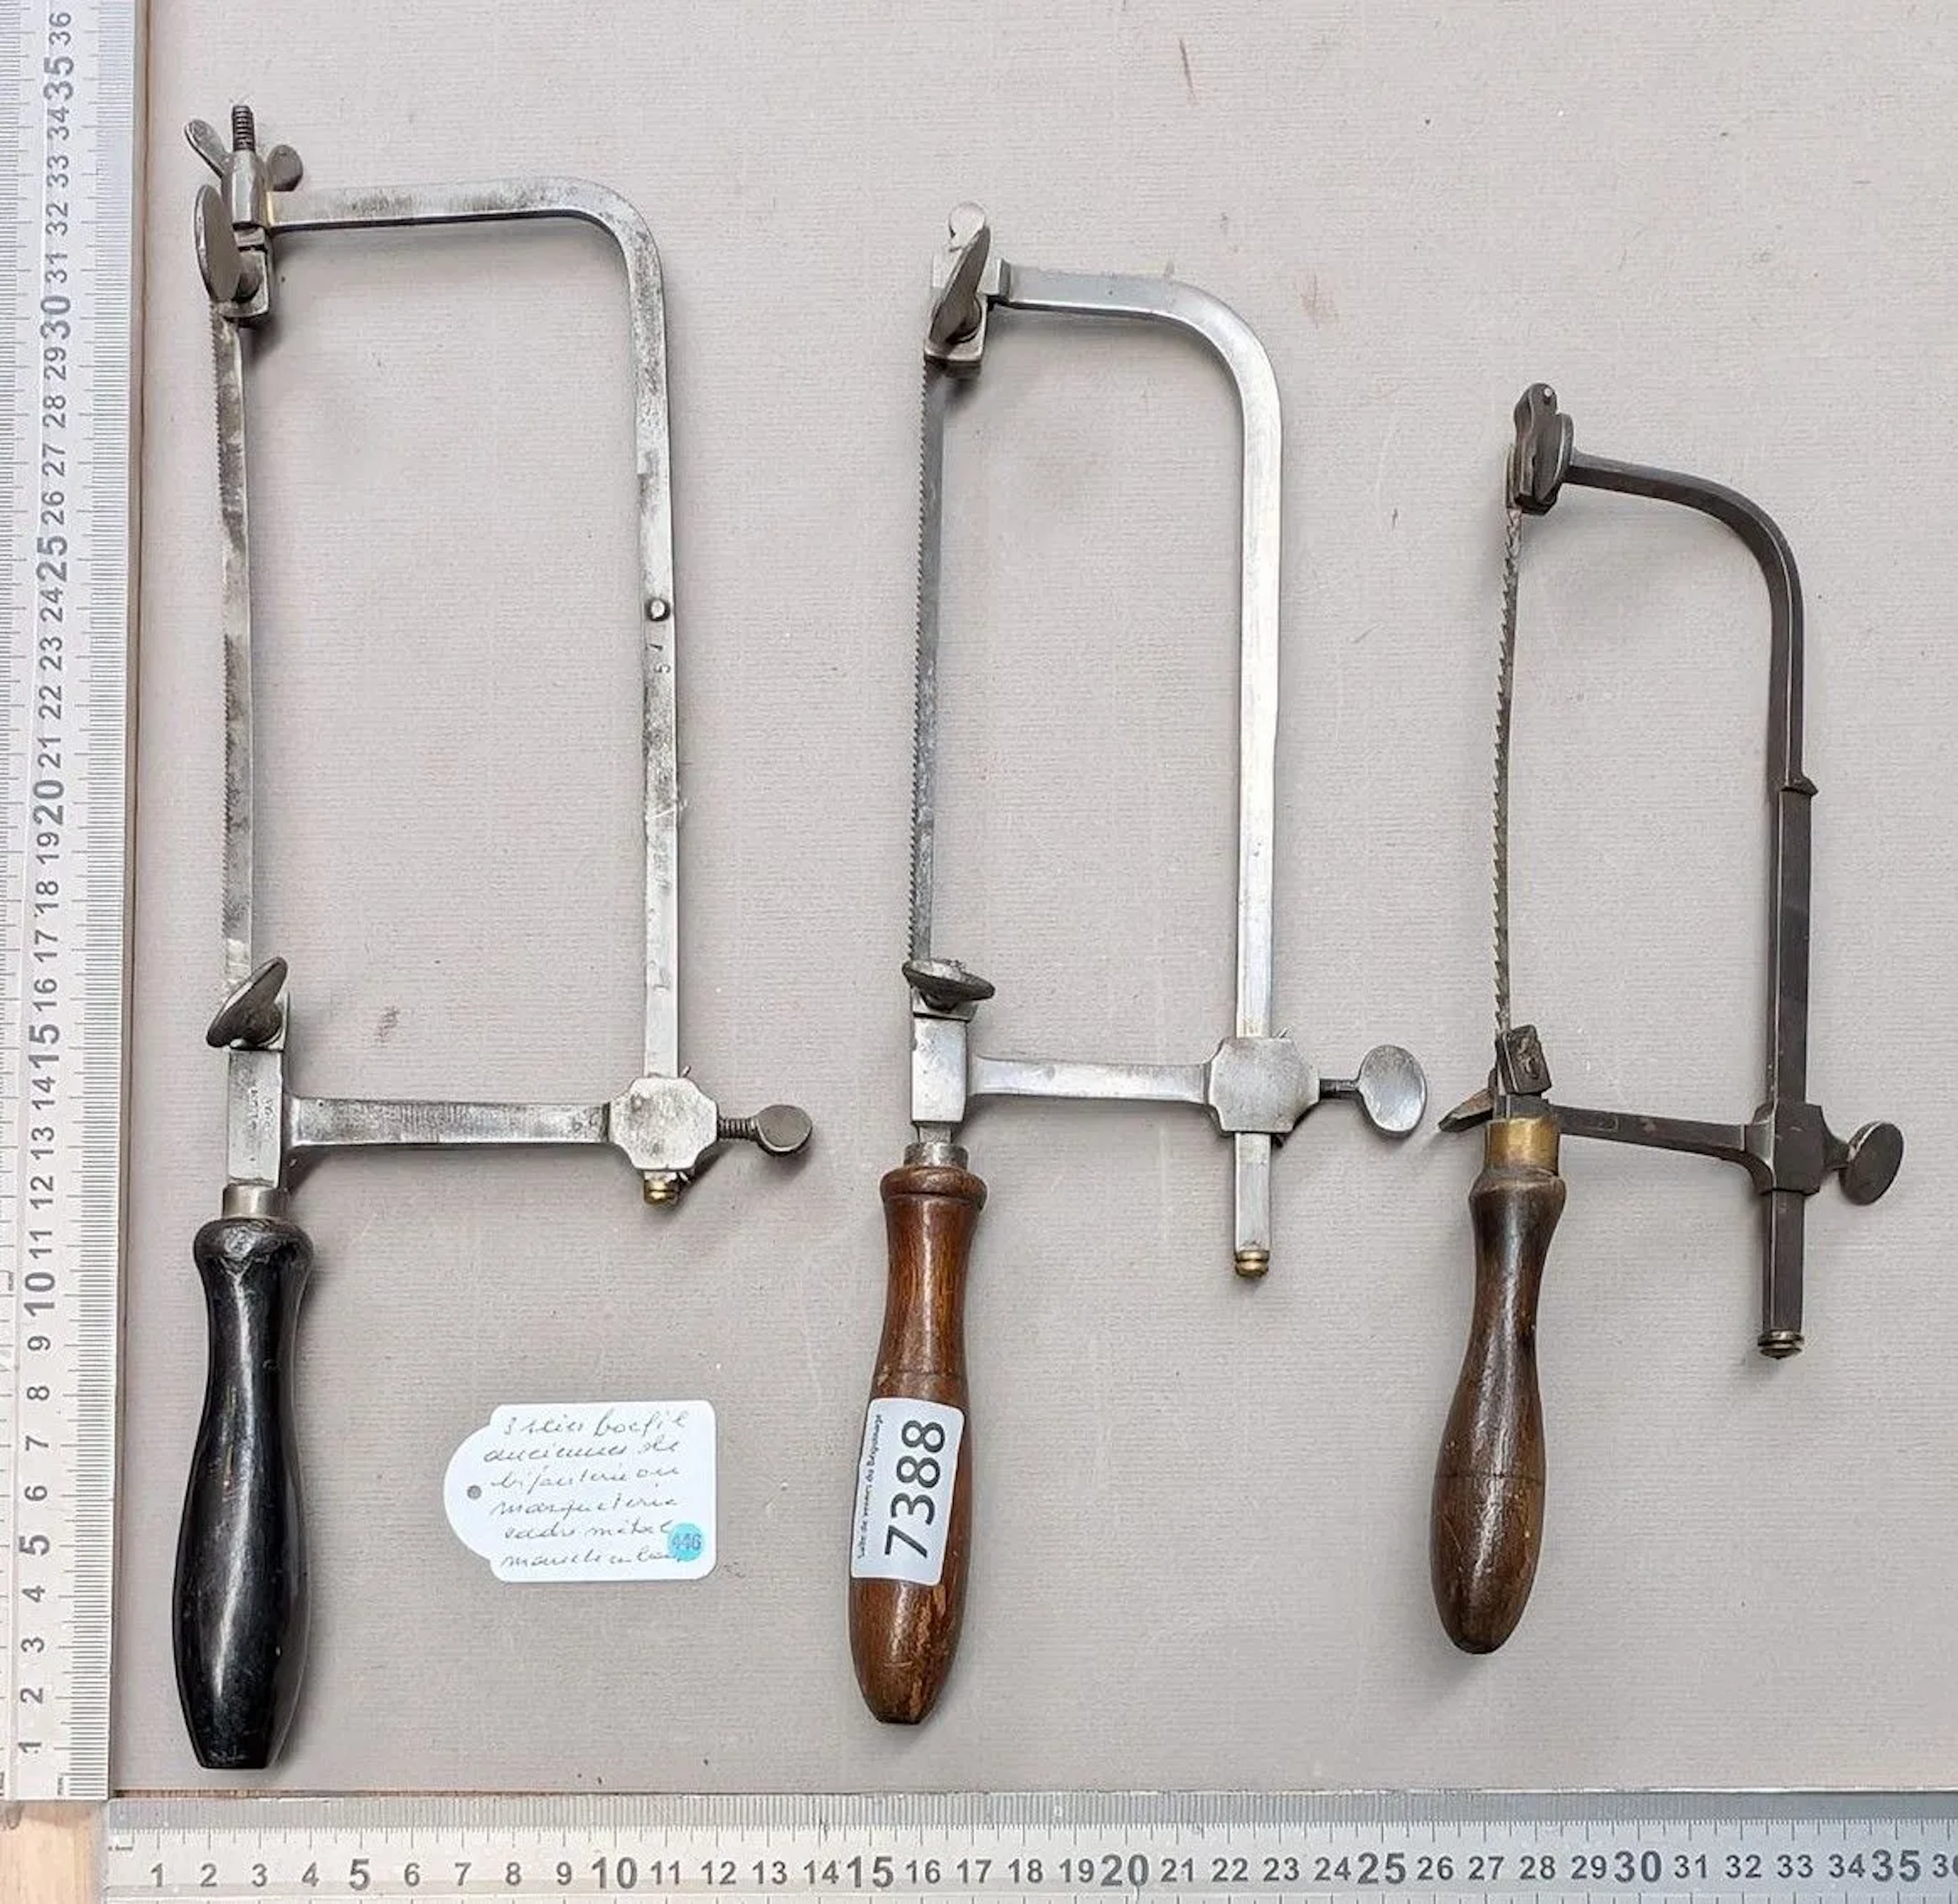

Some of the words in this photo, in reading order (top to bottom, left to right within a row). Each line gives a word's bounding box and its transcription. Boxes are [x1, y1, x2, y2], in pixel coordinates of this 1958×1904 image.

[48, 12, 71, 46] 36
[43, 57, 74, 101] 35
[46, 106, 70, 141] 34
[46, 155, 69, 188] 33
[45, 202, 68, 237] 32
[44, 252, 68, 284] 31
[40, 295, 71, 340] 30
[43, 347, 67, 381] 29
[42, 395, 66, 428] 28
[41, 443, 66, 477] 27
[40, 491, 65, 526] 26
[36, 535, 68, 582] 25
[39, 587, 63, 623] 24
[38, 636, 63, 672] 23
[38, 685, 62, 720] 22
[37, 737, 61, 769] 21
[32, 780, 64, 826] 20
[35, 832, 60, 865] 19
[34, 881, 59, 914] 18
[33, 929, 58, 963] 17
[32, 978, 58, 1012] 16
[28, 1024, 60, 1069] 15
[31, 1076, 56, 1111] 14
[30, 1126, 55, 1161] 13
[29, 1175, 54, 1210] 12
[28, 1230, 53, 1259] 11
[23, 1272, 56, 1317] 10
[27, 1335, 51, 1352] 9
[26, 1385, 50, 1402] 8
[25, 1435, 49, 1452] 7
[24, 1485, 48, 1502] 6
[885, 1420, 945, 1559] 7388
[18, 1535, 50, 1556] 5
[21, 1585, 45, 1603] 4
[20, 1636, 45, 1654] 3
[19, 1687, 43, 1705] 2
[17, 1742, 42, 1754] 1
[150, 1863, 164, 1888] 1
[199, 1863, 218, 1888] 2
[251, 1863, 268, 1888] 3
[301, 1862, 320, 1888] 4
[348, 1858, 371, 1891] 5
[404, 1862, 420, 1888] 6
[454, 1862, 472, 1887] 7
[505, 1862, 522, 1887] 8
[556, 1861, 572, 1886] 9
[591, 1857, 638, 1890] 10
[650, 1860, 680, 1886] 11
[701, 1860, 737, 1886] 12
[752, 1860, 788, 1886] 13
[803, 1860, 840, 1885] 14
[846, 1856, 894, 1892] 15
[905, 1859, 941, 1885] 16
[957, 1858, 992, 1885] 17
[1008, 1858, 1043, 1884] 18
[1059, 1858, 1095, 1884] 19
[1100, 1854, 1150, 1887] 20
[1160, 1857, 1194, 1883] 21
[1211, 1857, 1249, 1883] 22
[1263, 1857, 1300, 1883] 23
[1313, 1856, 1352, 1882] 24
[1356, 1852, 1406, 1886] 25
[1416, 1856, 1454, 1881] 26
[1467, 1856, 1505, 1881] 27
[1519, 1855, 1556, 1881] 28
[1571, 1855, 1607, 1881] 29
[1614, 1850, 1662, 1884] 30
[1674, 1854, 1707, 1880] 31
[1725, 1854, 1762, 1879] 32
[1776, 1854, 1814, 1879] 33
[1828, 1853, 1866, 1879] 34
[1872, 1849, 1921, 1883] 35
